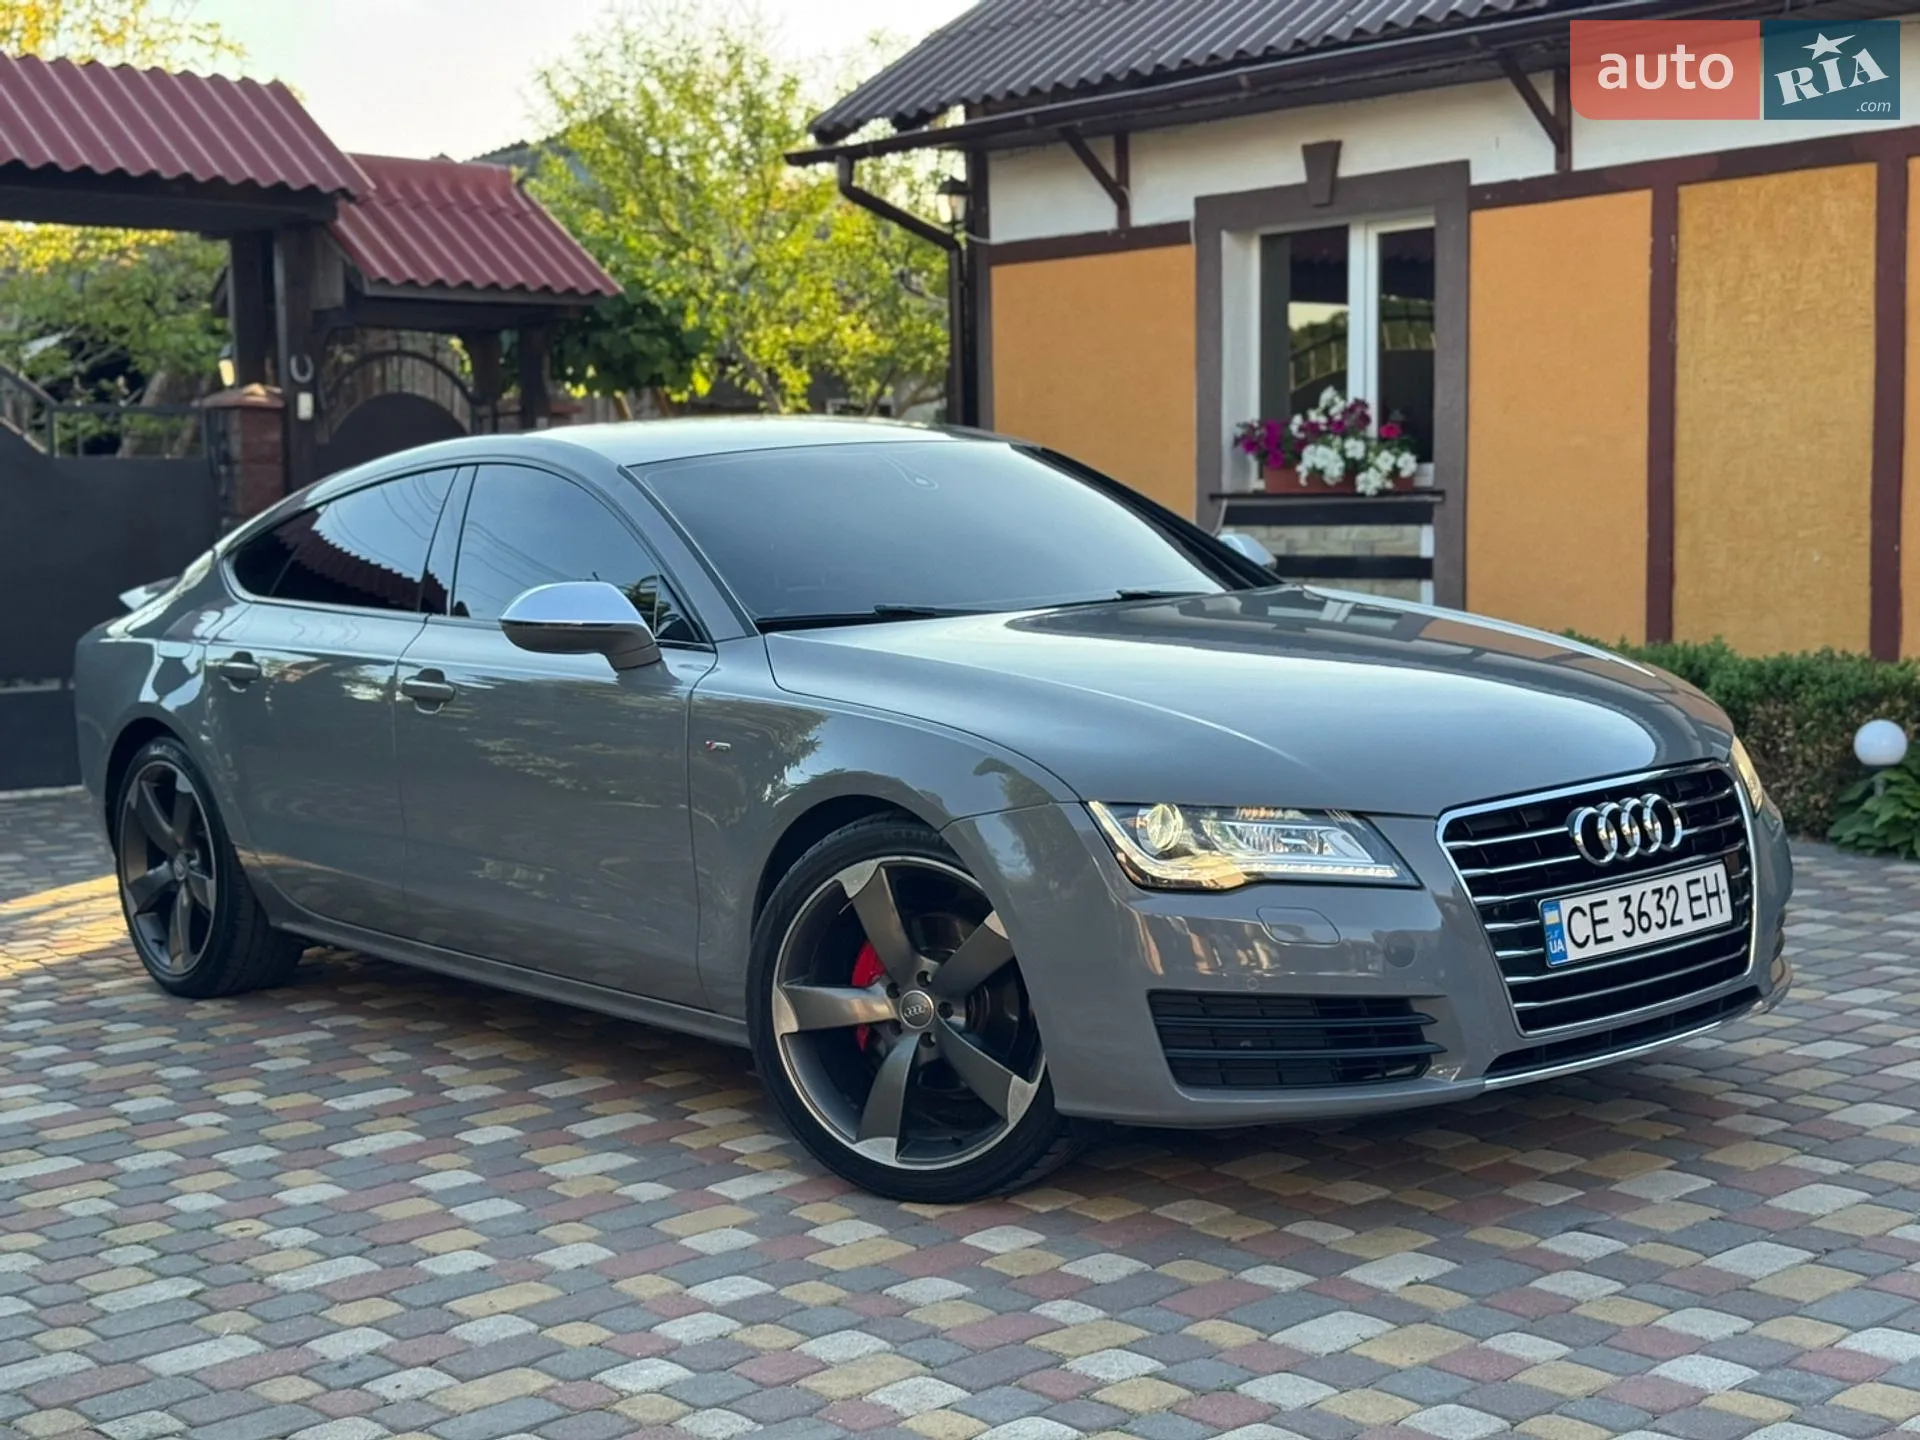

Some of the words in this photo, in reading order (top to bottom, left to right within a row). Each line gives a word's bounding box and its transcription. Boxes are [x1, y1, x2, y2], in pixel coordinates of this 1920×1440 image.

[1566, 900, 1614, 949] CE
[1618, 884, 1684, 938] 3632
[1686, 872, 1724, 922] EH
[1549, 939, 1566, 954] UA
